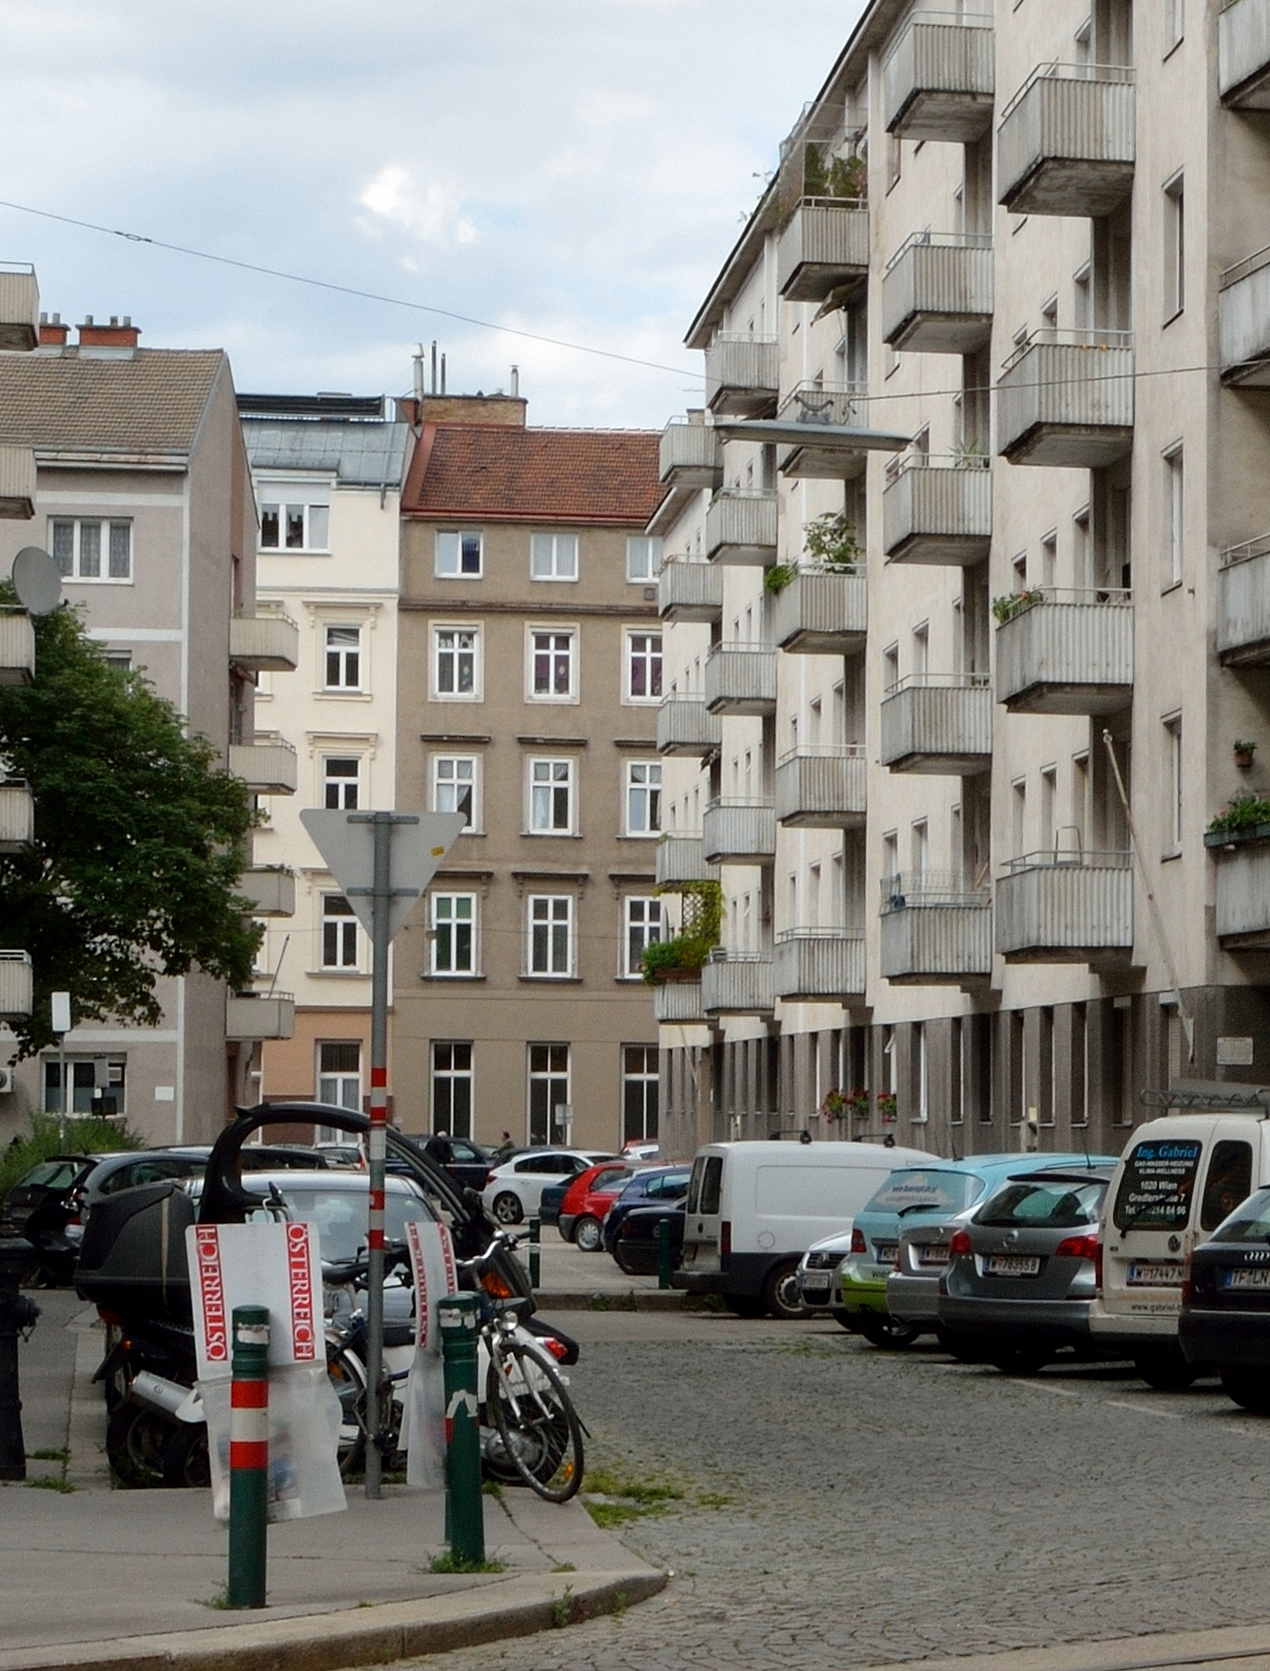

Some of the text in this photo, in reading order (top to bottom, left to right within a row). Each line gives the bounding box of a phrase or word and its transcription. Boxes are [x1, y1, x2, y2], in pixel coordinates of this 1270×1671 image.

[1136, 1145, 1198, 1159] Ing. Gabriel
[1158, 1180, 1178, 1190] Wien
[198, 1226, 226, 1361] ÖSTERREICH
[287, 1224, 314, 1358] ÖSTERREICH
